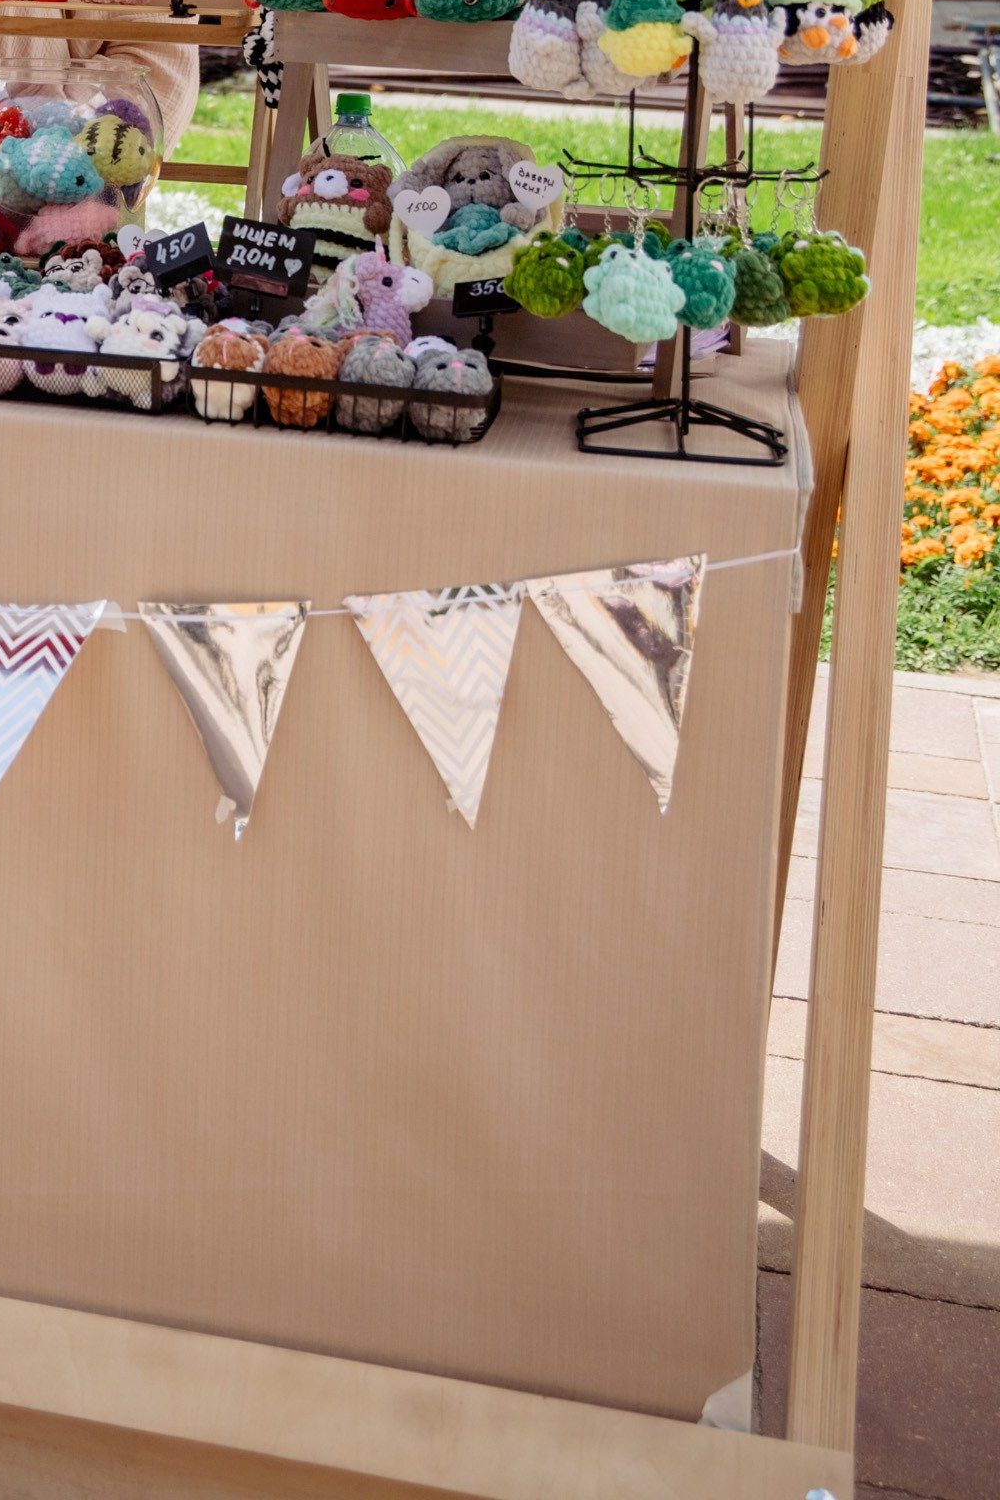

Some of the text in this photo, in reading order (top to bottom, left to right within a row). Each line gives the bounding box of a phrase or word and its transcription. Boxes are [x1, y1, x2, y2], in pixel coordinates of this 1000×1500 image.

[406, 201, 438, 213] 1500
[155, 232, 196, 265] 450
[232, 222, 297, 252] ИЩЕМ
[226, 244, 277, 271] ДОМ
